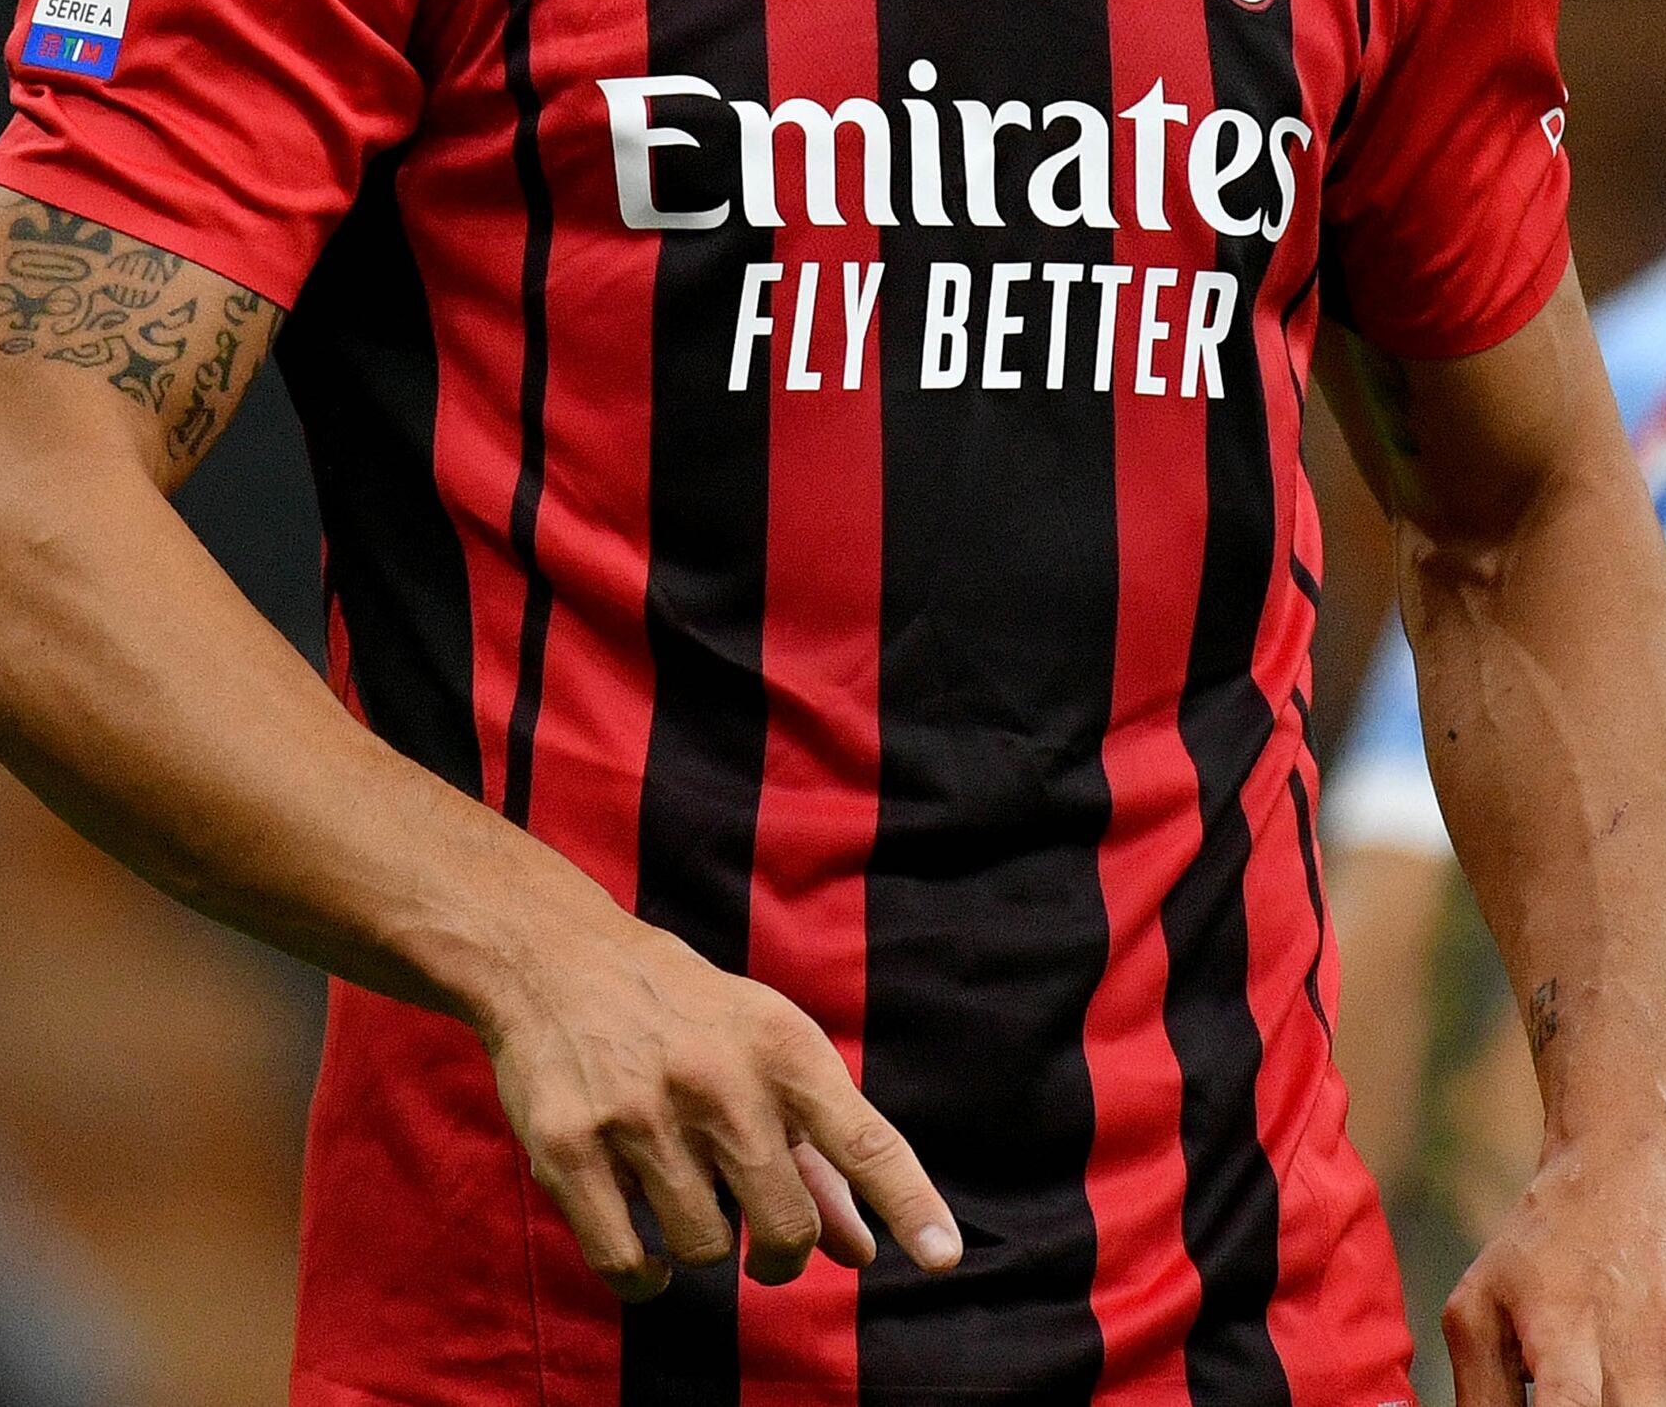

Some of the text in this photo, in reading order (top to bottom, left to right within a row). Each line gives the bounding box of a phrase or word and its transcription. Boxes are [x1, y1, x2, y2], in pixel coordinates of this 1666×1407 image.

[63, 36, 103, 66] TIM
[99, 6, 112, 28] A
[595, 58, 1313, 244] Emirates
[728, 261, 1239, 400] FLY BETTER
